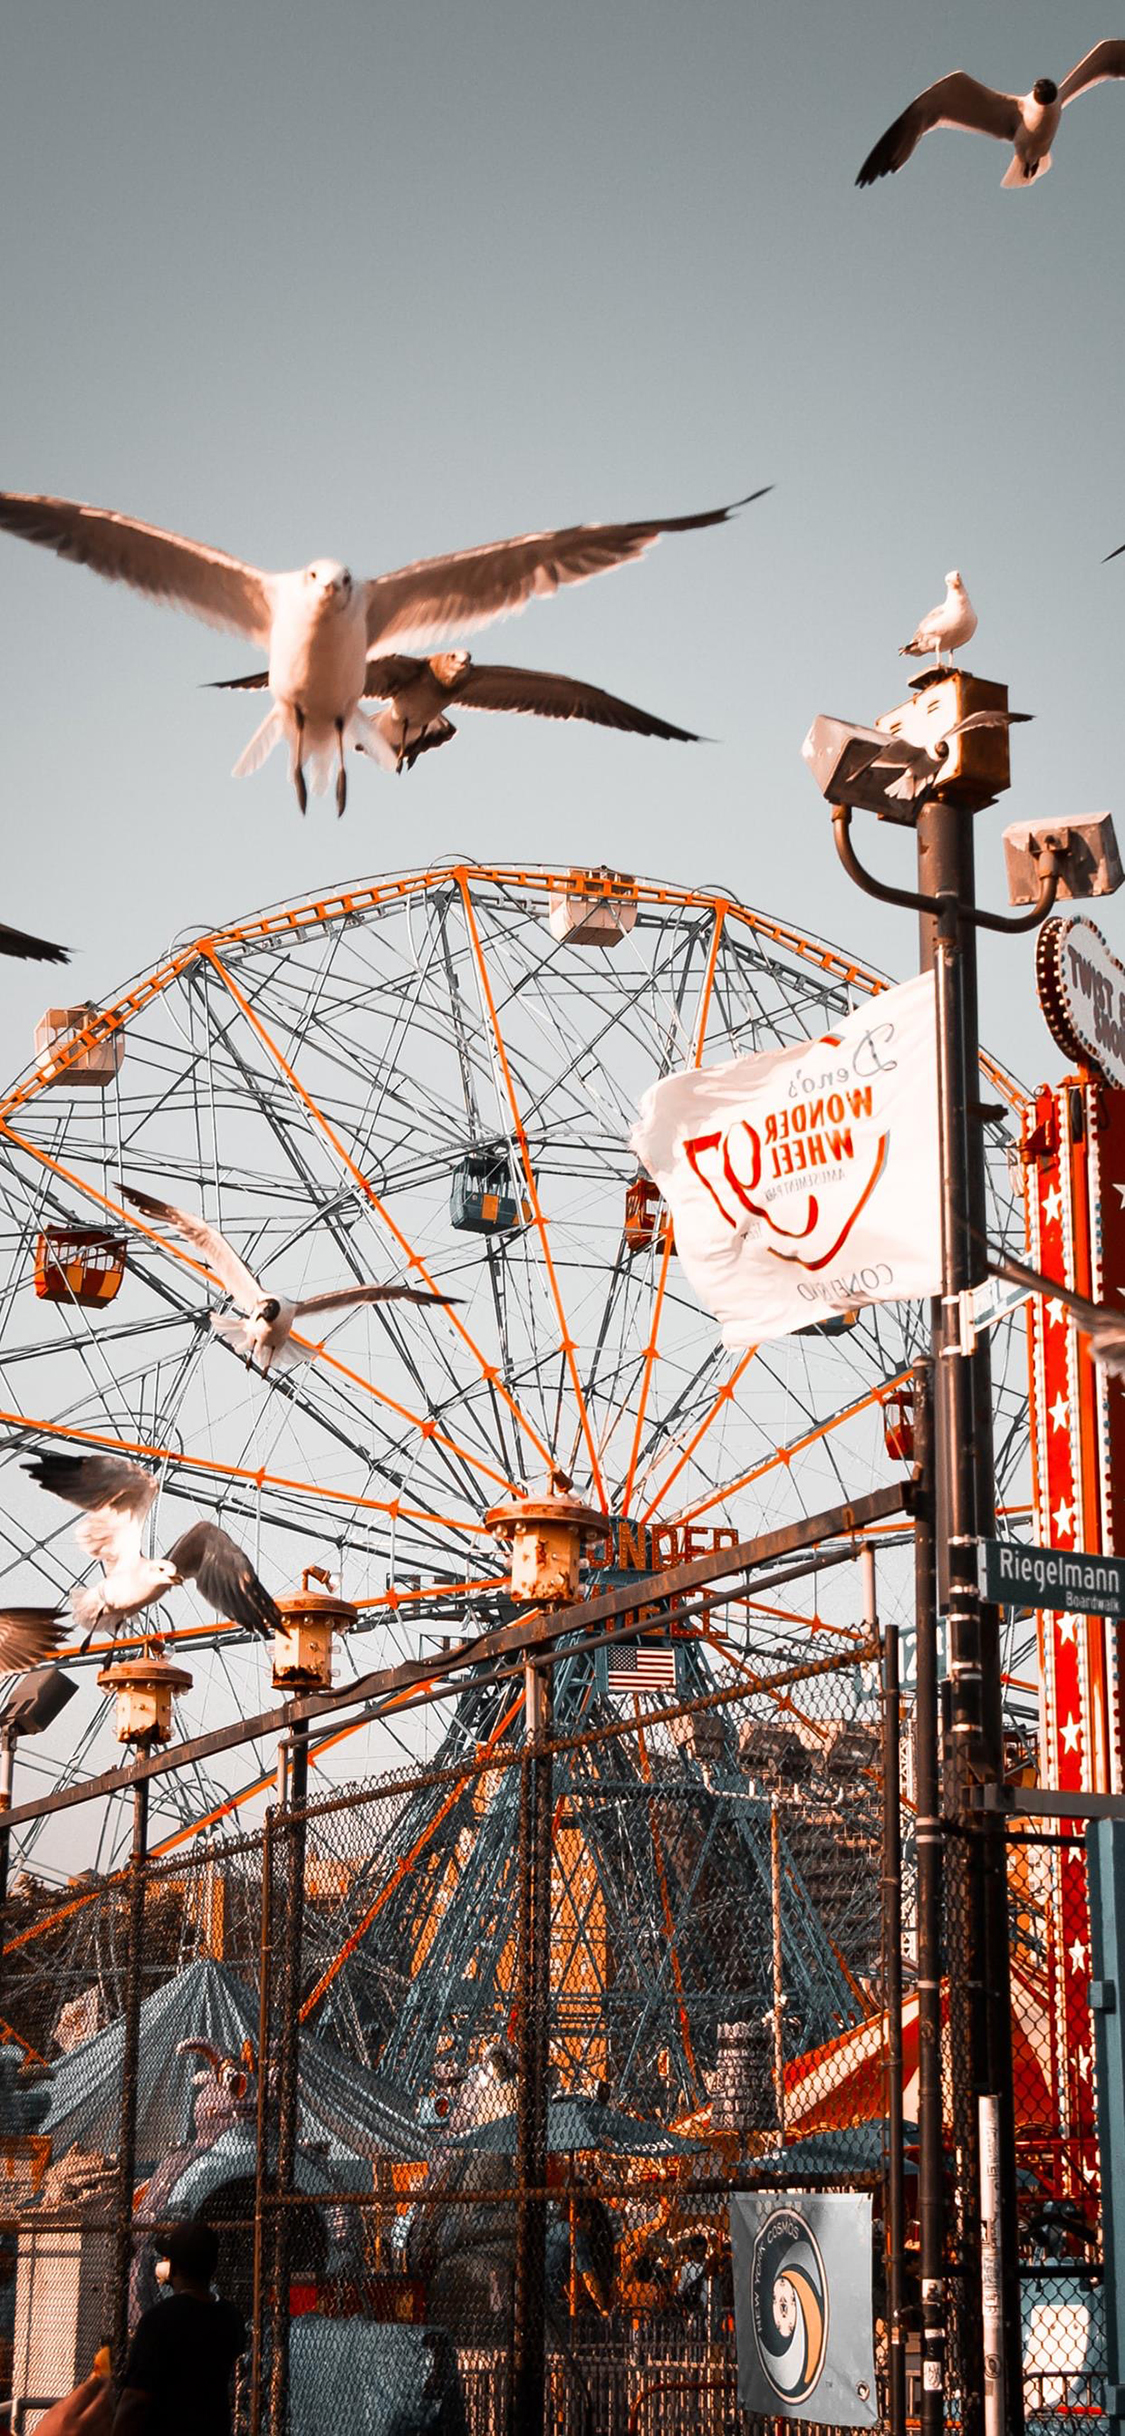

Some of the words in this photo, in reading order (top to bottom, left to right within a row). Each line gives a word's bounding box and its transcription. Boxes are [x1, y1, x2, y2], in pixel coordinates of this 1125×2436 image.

[999, 1547, 1120, 1594] Riegelmann
[1065, 1590, 1120, 1613] Boardwalk
[753, 2290, 764, 2333] NEW
[766, 2220, 800, 2244] COSMOS
